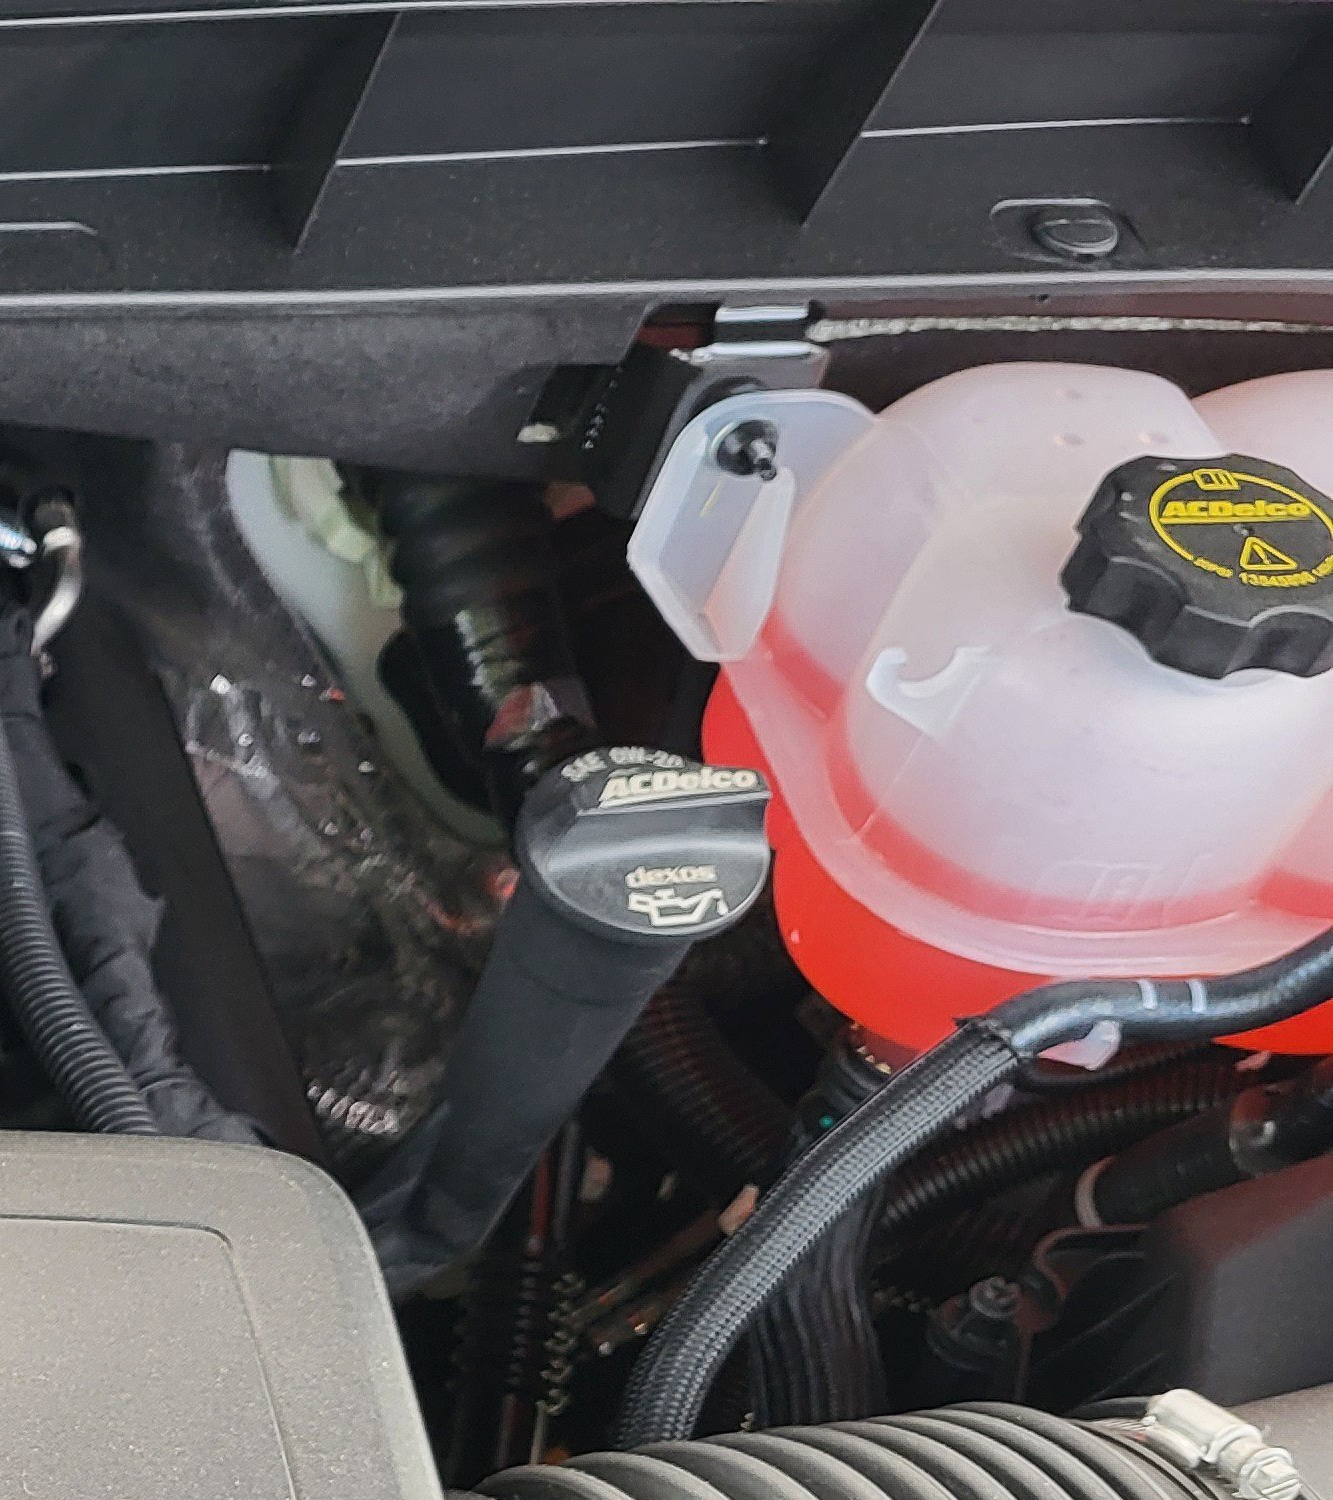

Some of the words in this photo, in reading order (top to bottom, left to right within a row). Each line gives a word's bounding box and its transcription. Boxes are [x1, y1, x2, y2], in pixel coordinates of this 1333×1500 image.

[1161, 500, 1311, 518] ACDelco
[598, 767, 758, 802] ACDelco
[625, 866, 717, 889] dexos
